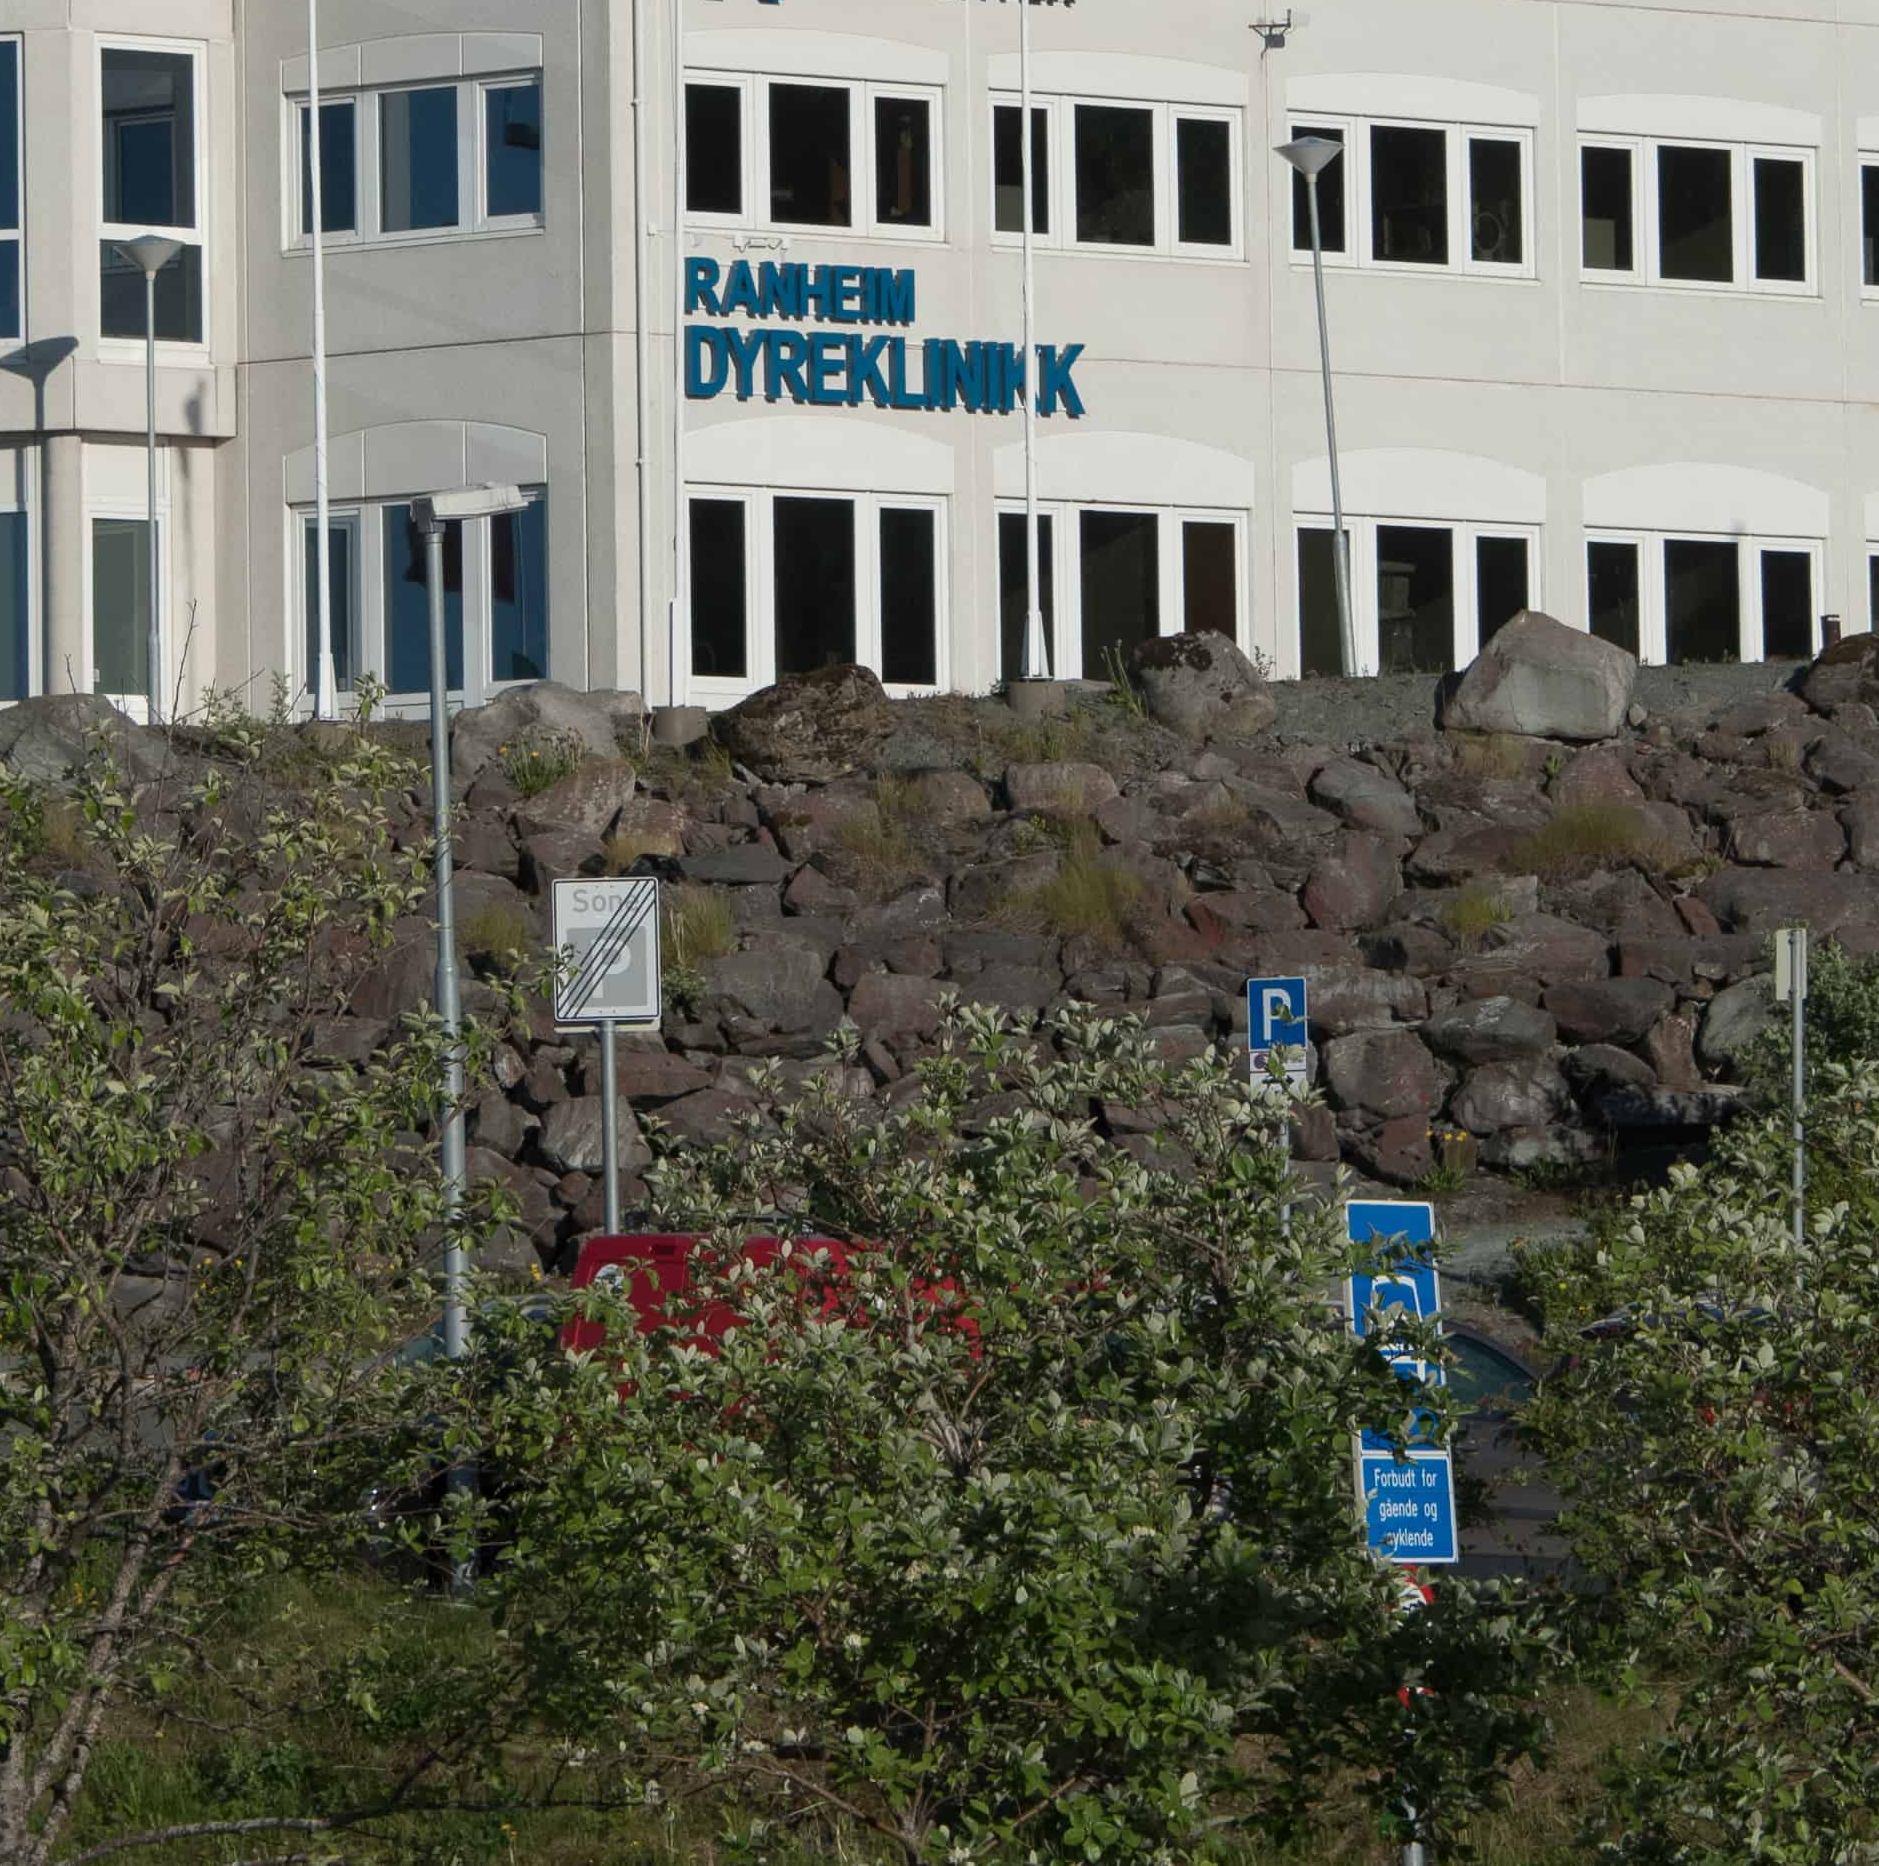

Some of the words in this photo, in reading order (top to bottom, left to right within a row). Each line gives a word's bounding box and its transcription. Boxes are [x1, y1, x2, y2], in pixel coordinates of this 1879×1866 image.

[684, 256, 916, 326] RANHEIM
[684, 325, 1086, 420] DYREKLINIKK
[1262, 988, 1291, 1040] P
[1374, 1467, 1416, 1487] Forbudt
[1421, 1468, 1437, 1487] for
[1379, 1498, 1418, 1522] gående
[1424, 1502, 1437, 1522] og
